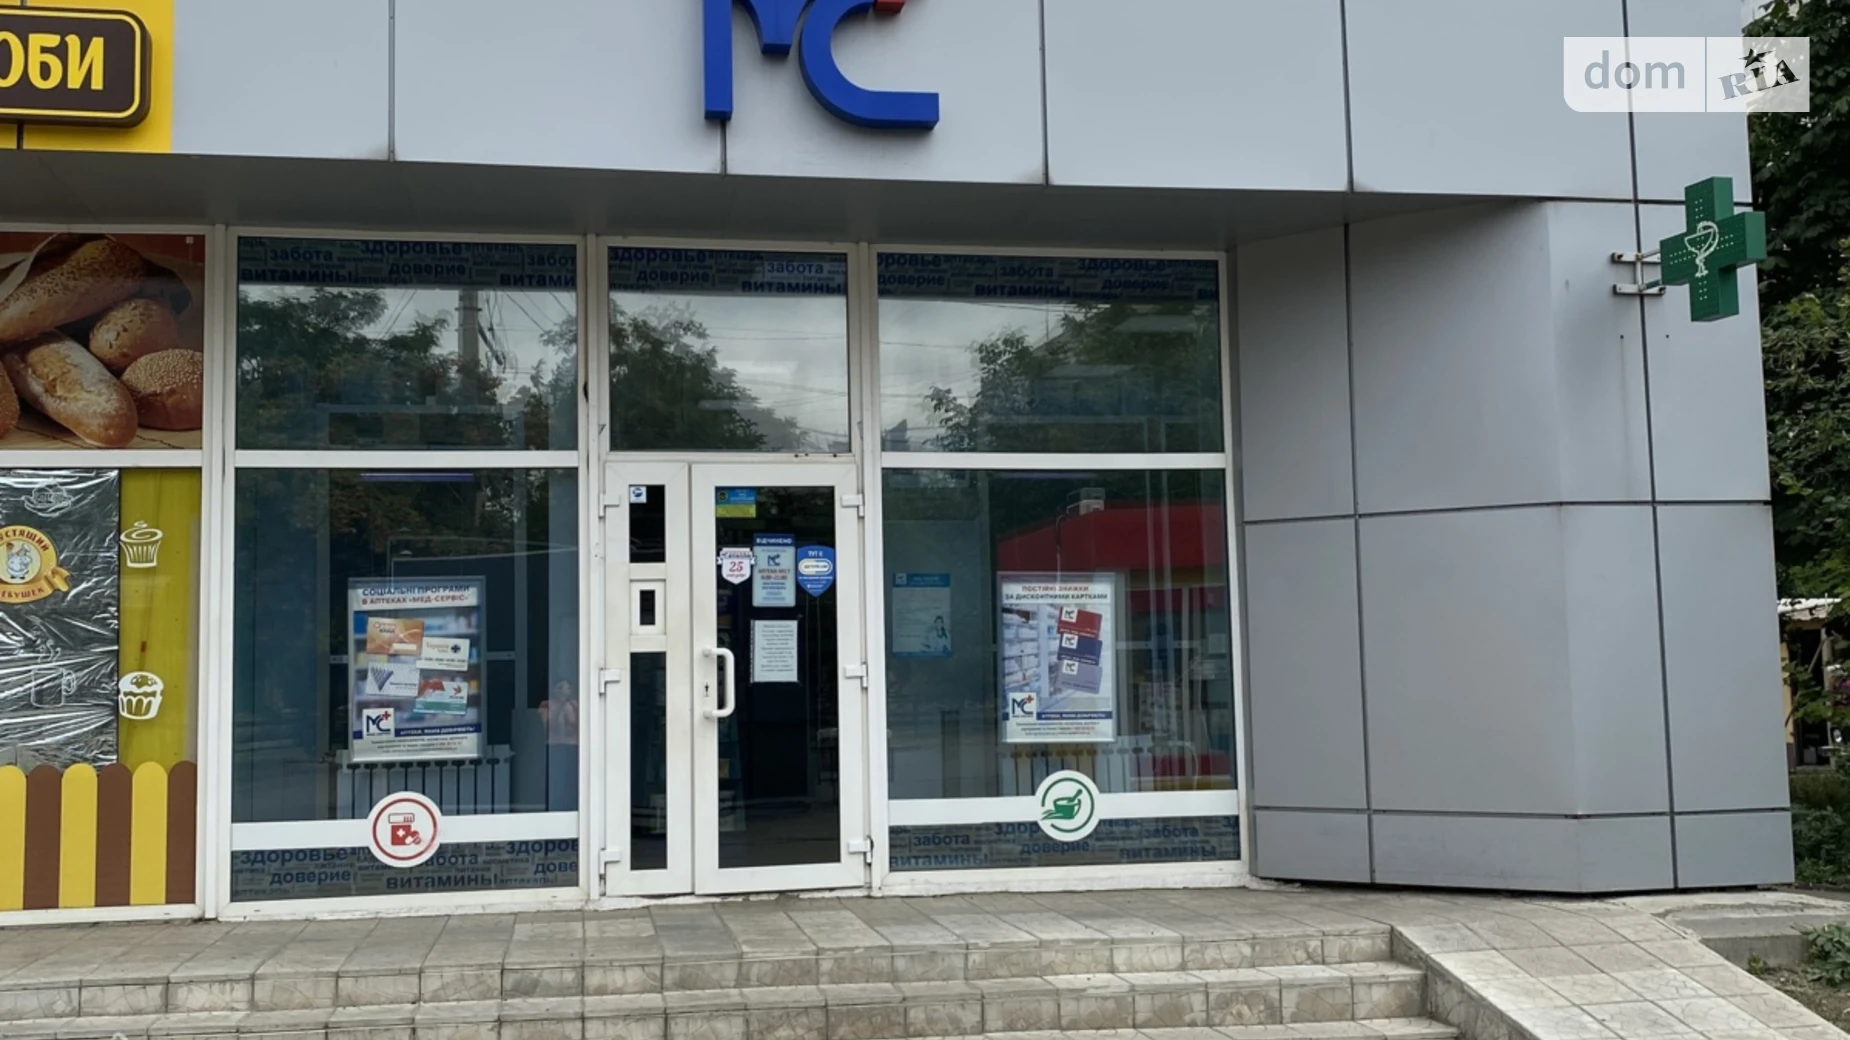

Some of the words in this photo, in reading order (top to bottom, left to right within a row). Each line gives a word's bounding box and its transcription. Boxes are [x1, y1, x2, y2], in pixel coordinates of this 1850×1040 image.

[269, 246, 333, 261] забота
[360, 241, 462, 258] здоровье
[241, 267, 352, 283] витамины
[389, 262, 466, 278] доверие
[767, 261, 823, 275] забота
[1000, 264, 1054, 278] забота
[636, 269, 710, 284] доверие
[878, 273, 945, 288] доверие
[742, 280, 842, 294] витамины
[975, 283, 1070, 298] витамины
[1101, 278, 1169, 292] доверие
[729, 560, 744, 572] 25
[369, 597, 407, 605] АПТЕКАХ
[913, 832, 971, 846] забота
[1143, 825, 1199, 839] забота
[1019, 840, 1090, 856] доверие
[1119, 845, 1217, 860] витамины
[240, 847, 348, 866] здоровье
[890, 853, 989, 867] витамины
[269, 870, 351, 886] доверие
[385, 873, 498, 890] витамины
